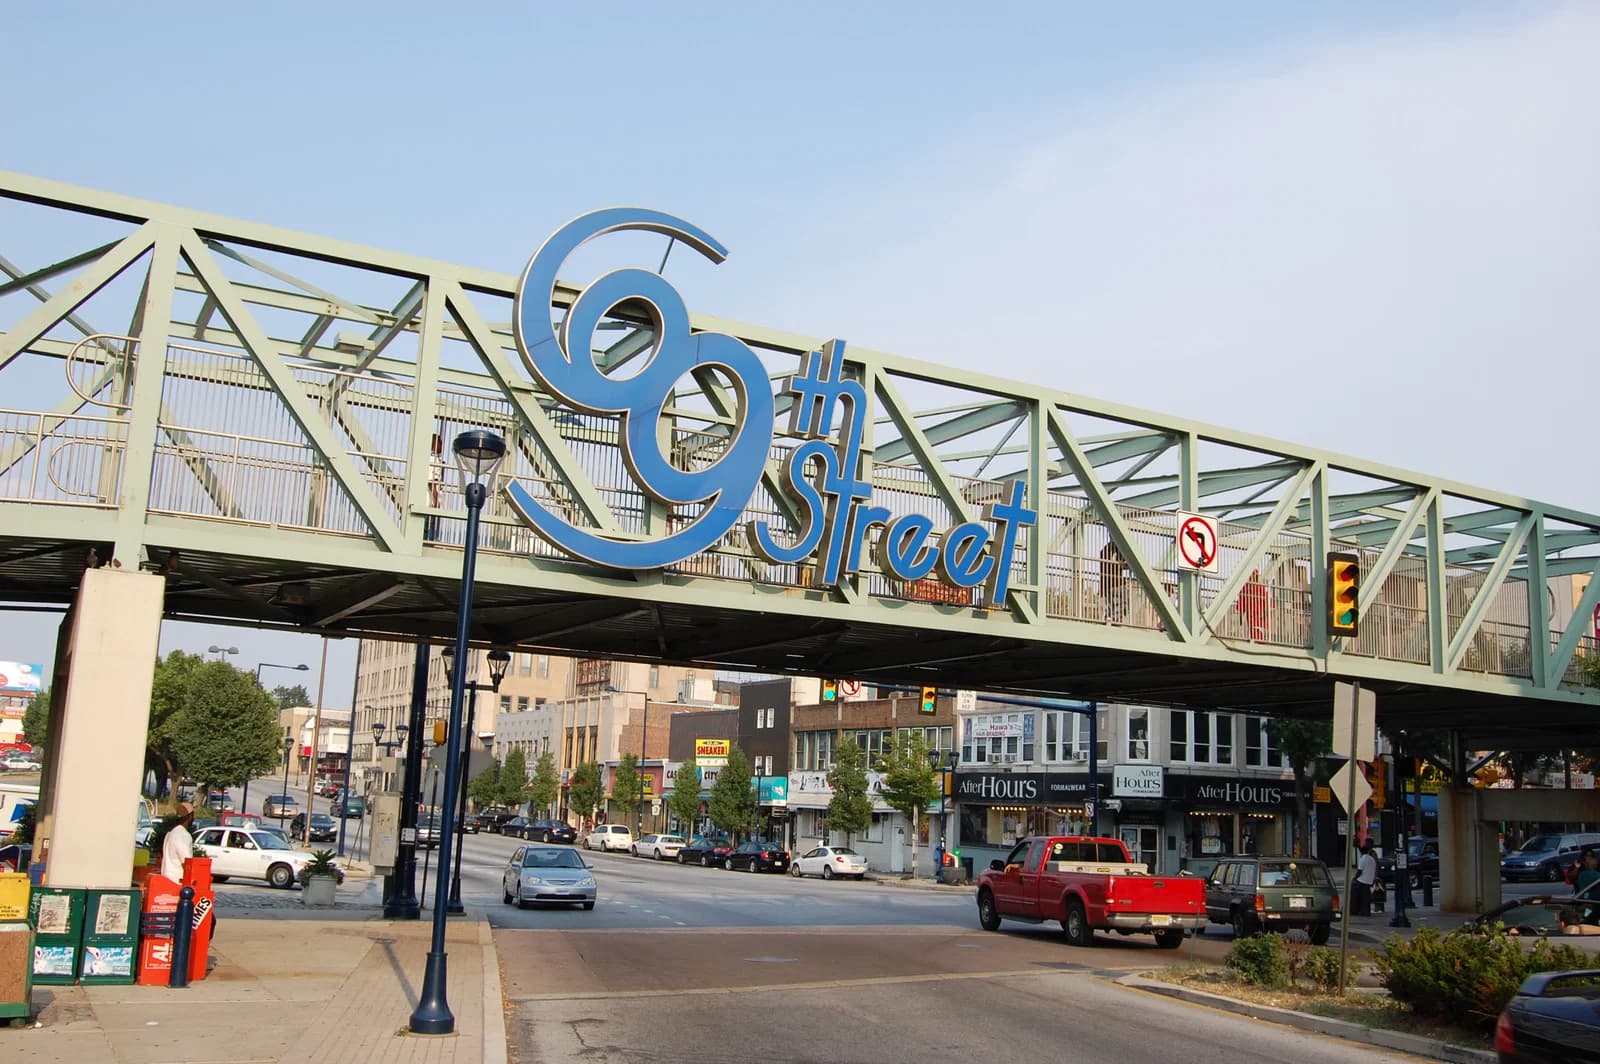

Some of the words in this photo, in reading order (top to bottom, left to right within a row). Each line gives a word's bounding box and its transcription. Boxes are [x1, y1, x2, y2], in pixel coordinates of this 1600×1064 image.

[747, 439, 1036, 606] Street
[1138, 768, 1161, 777] After
[959, 779, 982, 793] After
[1197, 784, 1226, 798] After
